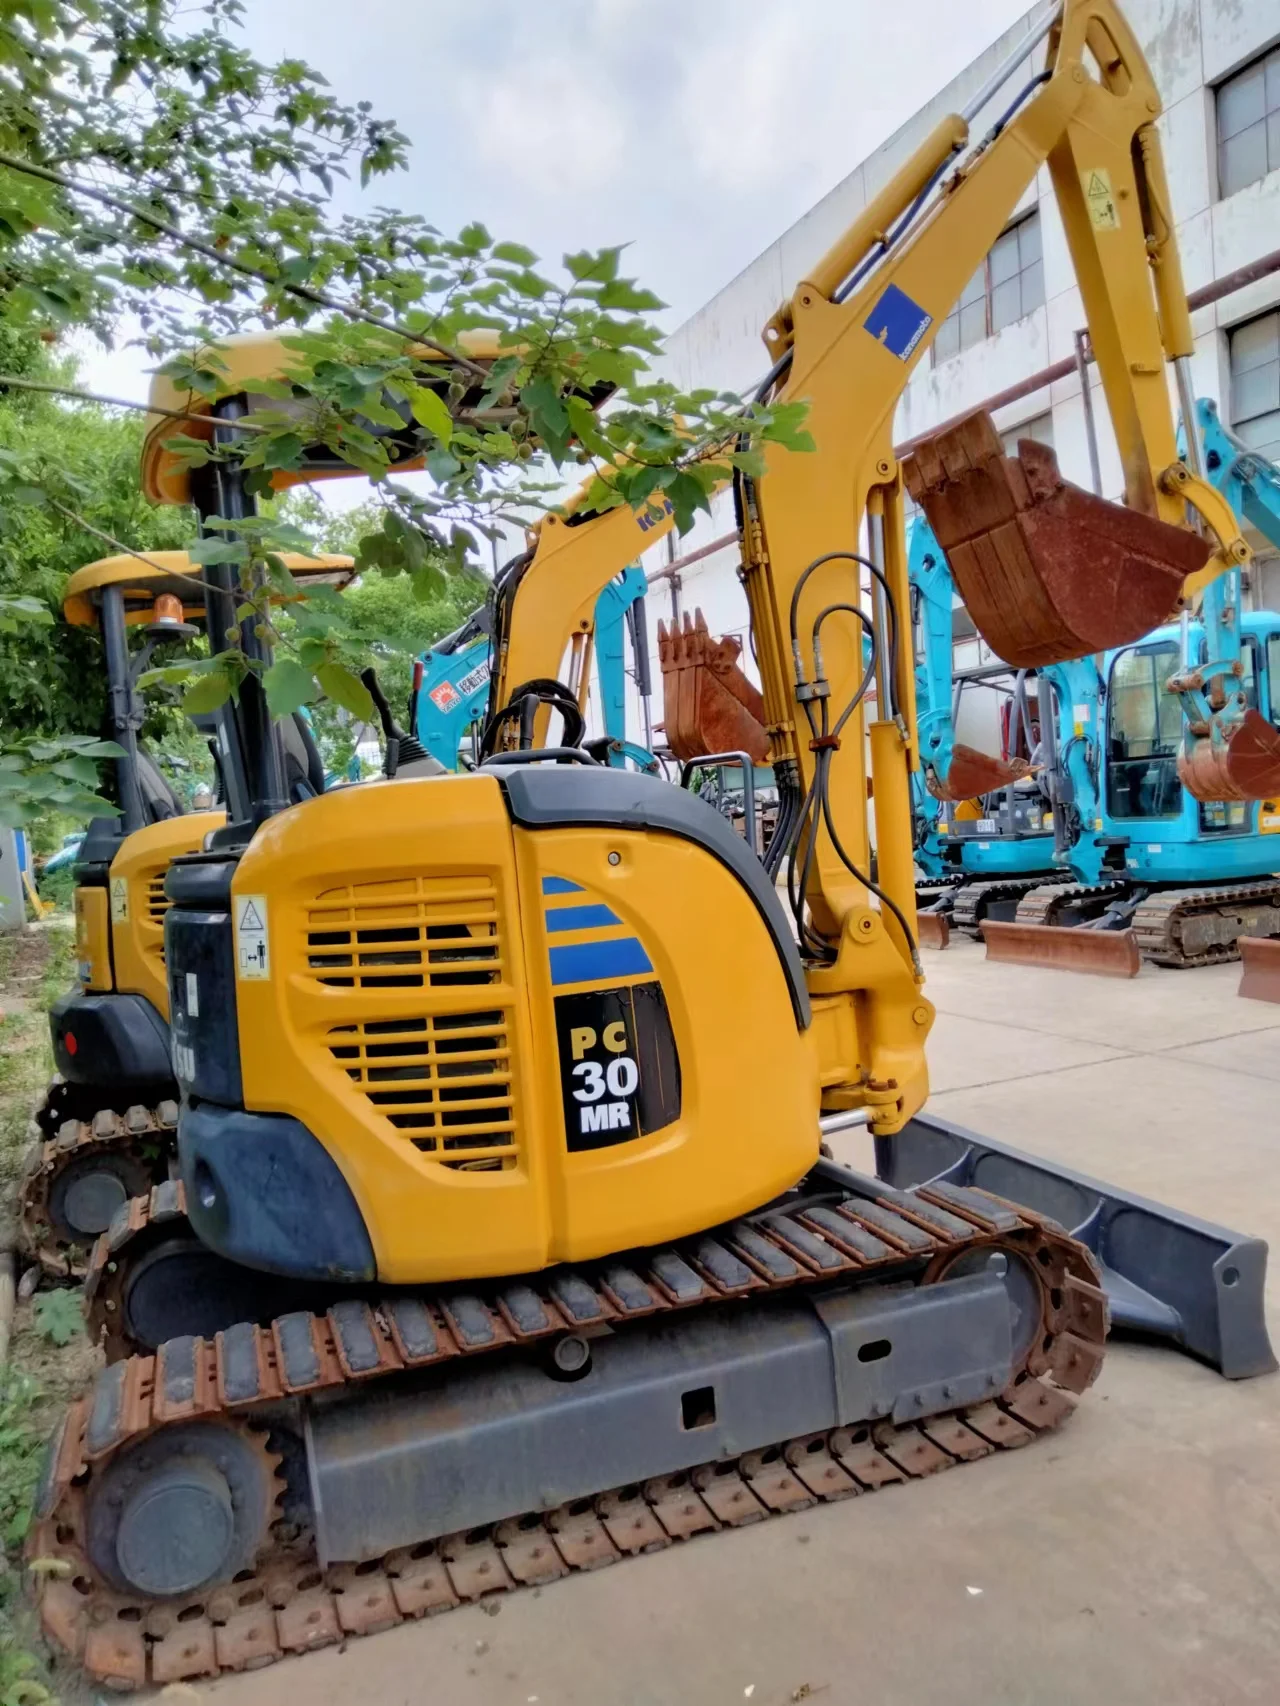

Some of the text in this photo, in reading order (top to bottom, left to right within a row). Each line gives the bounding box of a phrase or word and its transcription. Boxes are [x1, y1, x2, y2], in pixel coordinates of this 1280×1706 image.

[570, 1021, 628, 1060] PC
[571, 1056, 639, 1102] 30
[580, 1101, 632, 1134] MR
